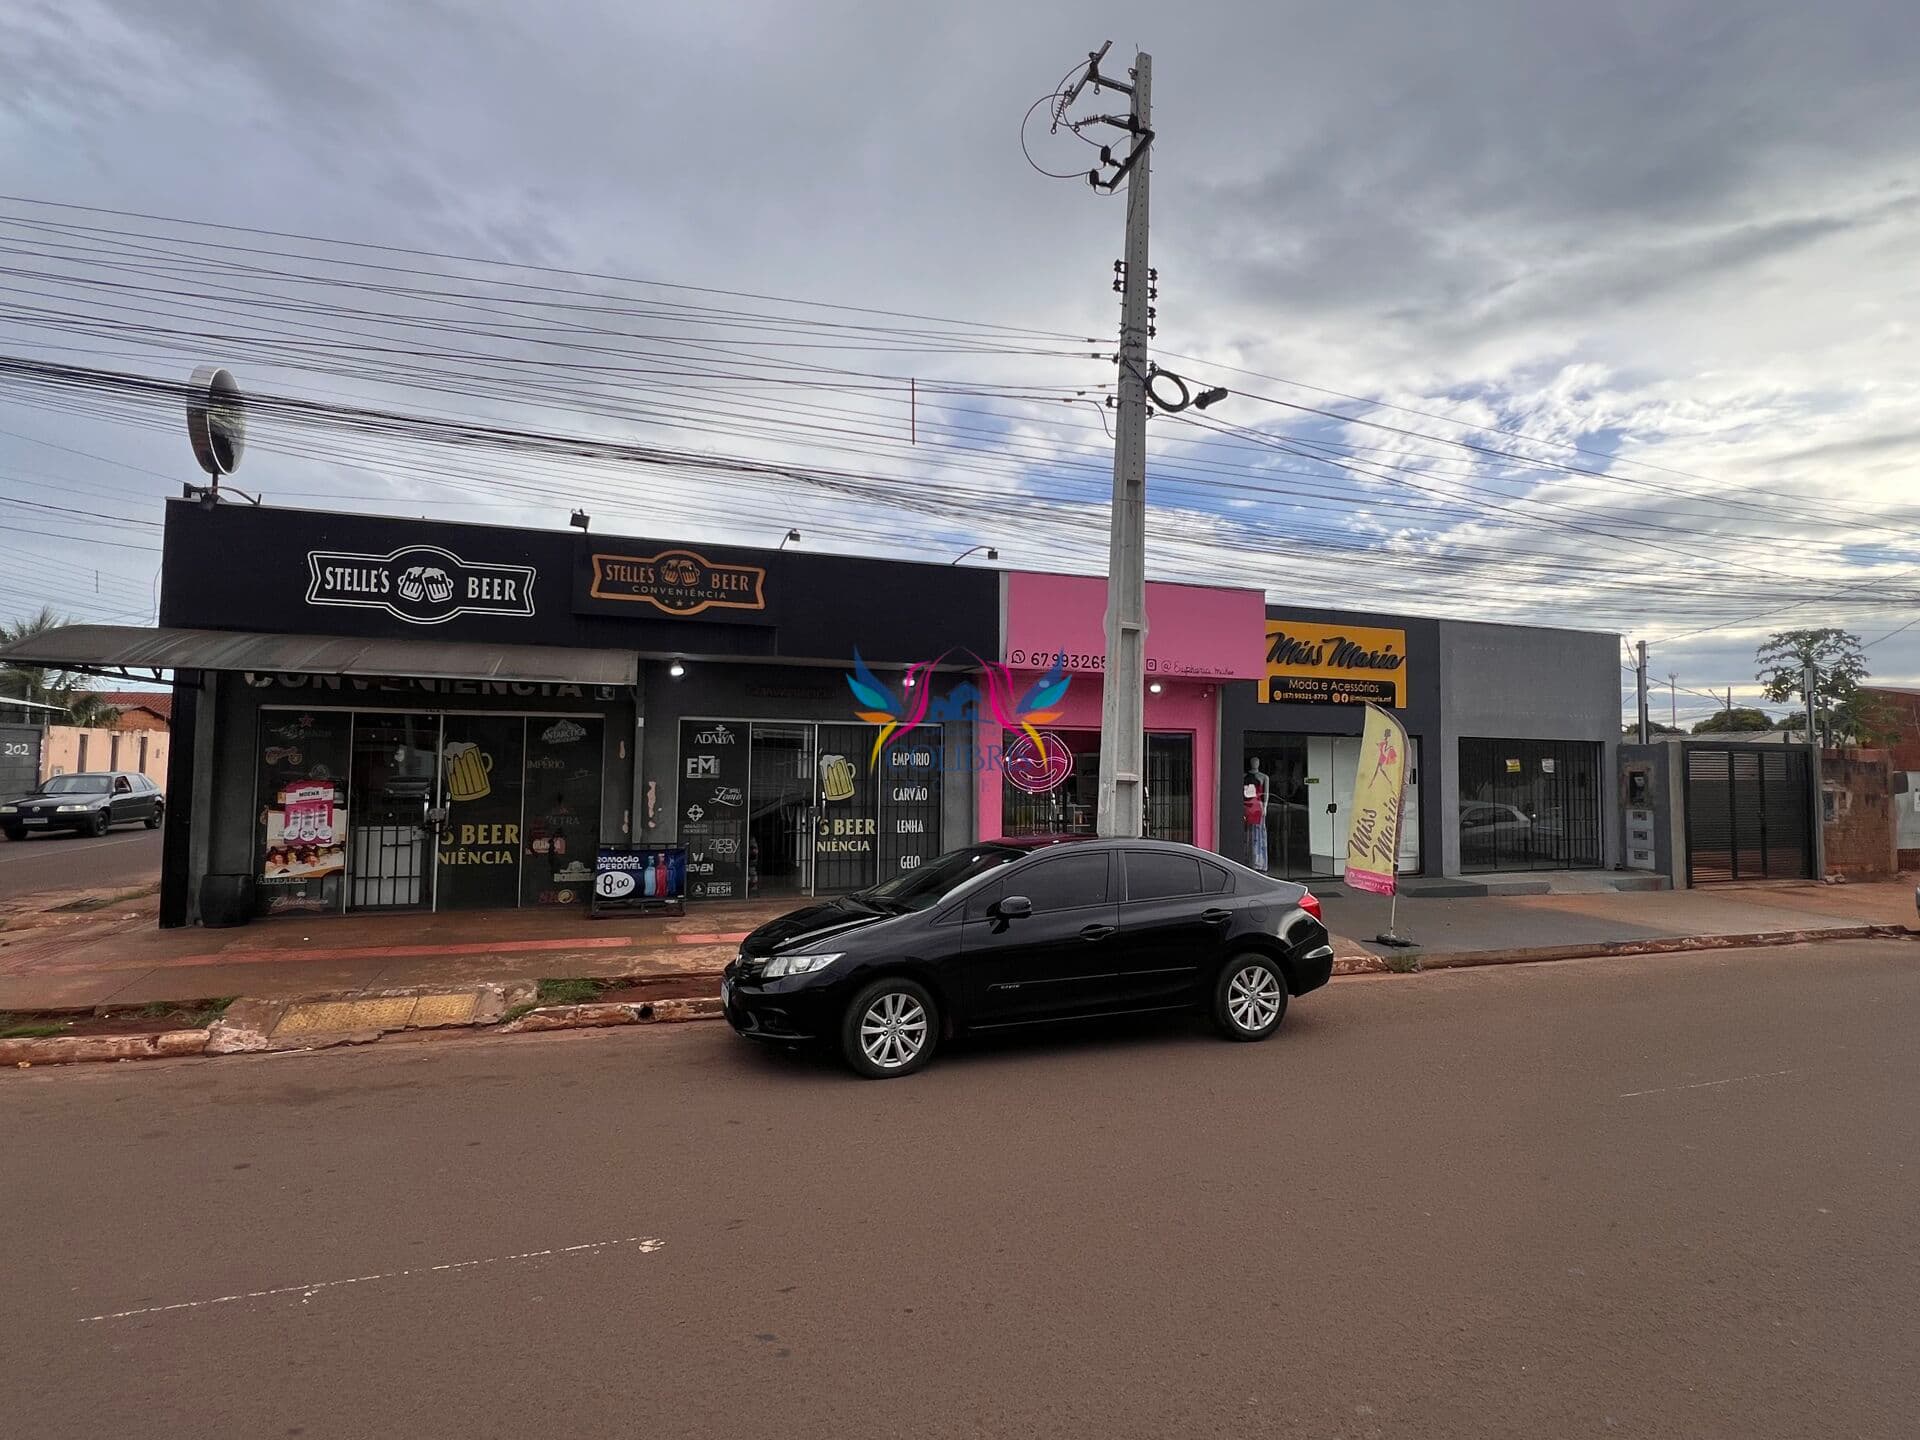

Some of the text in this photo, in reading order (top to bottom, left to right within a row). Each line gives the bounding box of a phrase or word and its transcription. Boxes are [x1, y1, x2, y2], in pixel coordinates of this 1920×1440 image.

[324, 566, 517, 601] STELLE'S BEER
[710, 573, 750, 592] BEER
[632, 585, 727, 599] CONVENIÊNCIA
[1265, 632, 1406, 669] Miss Maria
[1288, 679, 1380, 693] Moda e Acessórios
[4, 742, 30, 756] 202
[892, 751, 930, 766] EMPÓRIO
[893, 785, 928, 801] CARVÃO
[834, 818, 876, 836] BEER
[896, 819, 924, 833] LENHA
[1347, 808, 1377, 859] Miss
[461, 824, 519, 845] BEER
[900, 855, 921, 869] GELO
